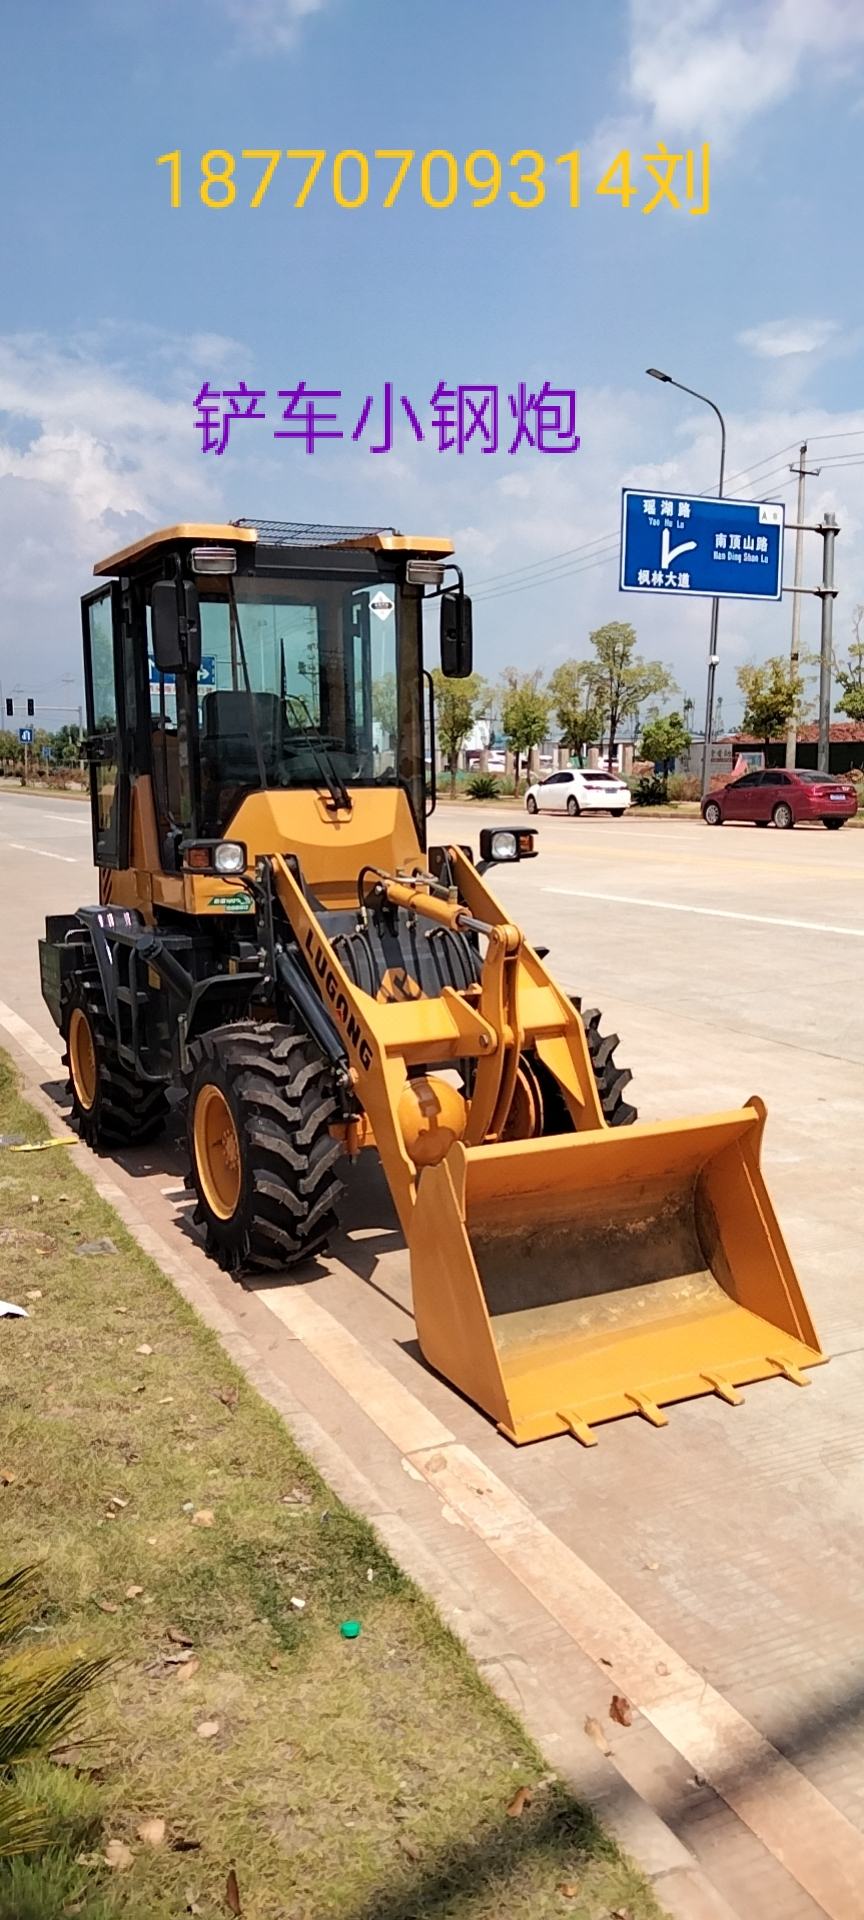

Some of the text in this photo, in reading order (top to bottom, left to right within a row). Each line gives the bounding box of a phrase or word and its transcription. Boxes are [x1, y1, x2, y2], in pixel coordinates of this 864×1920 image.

[643, 499, 691, 518] 瑶湖路
[715, 533, 768, 552] 南顶山路
[638, 569, 690, 588] 枫林大道
